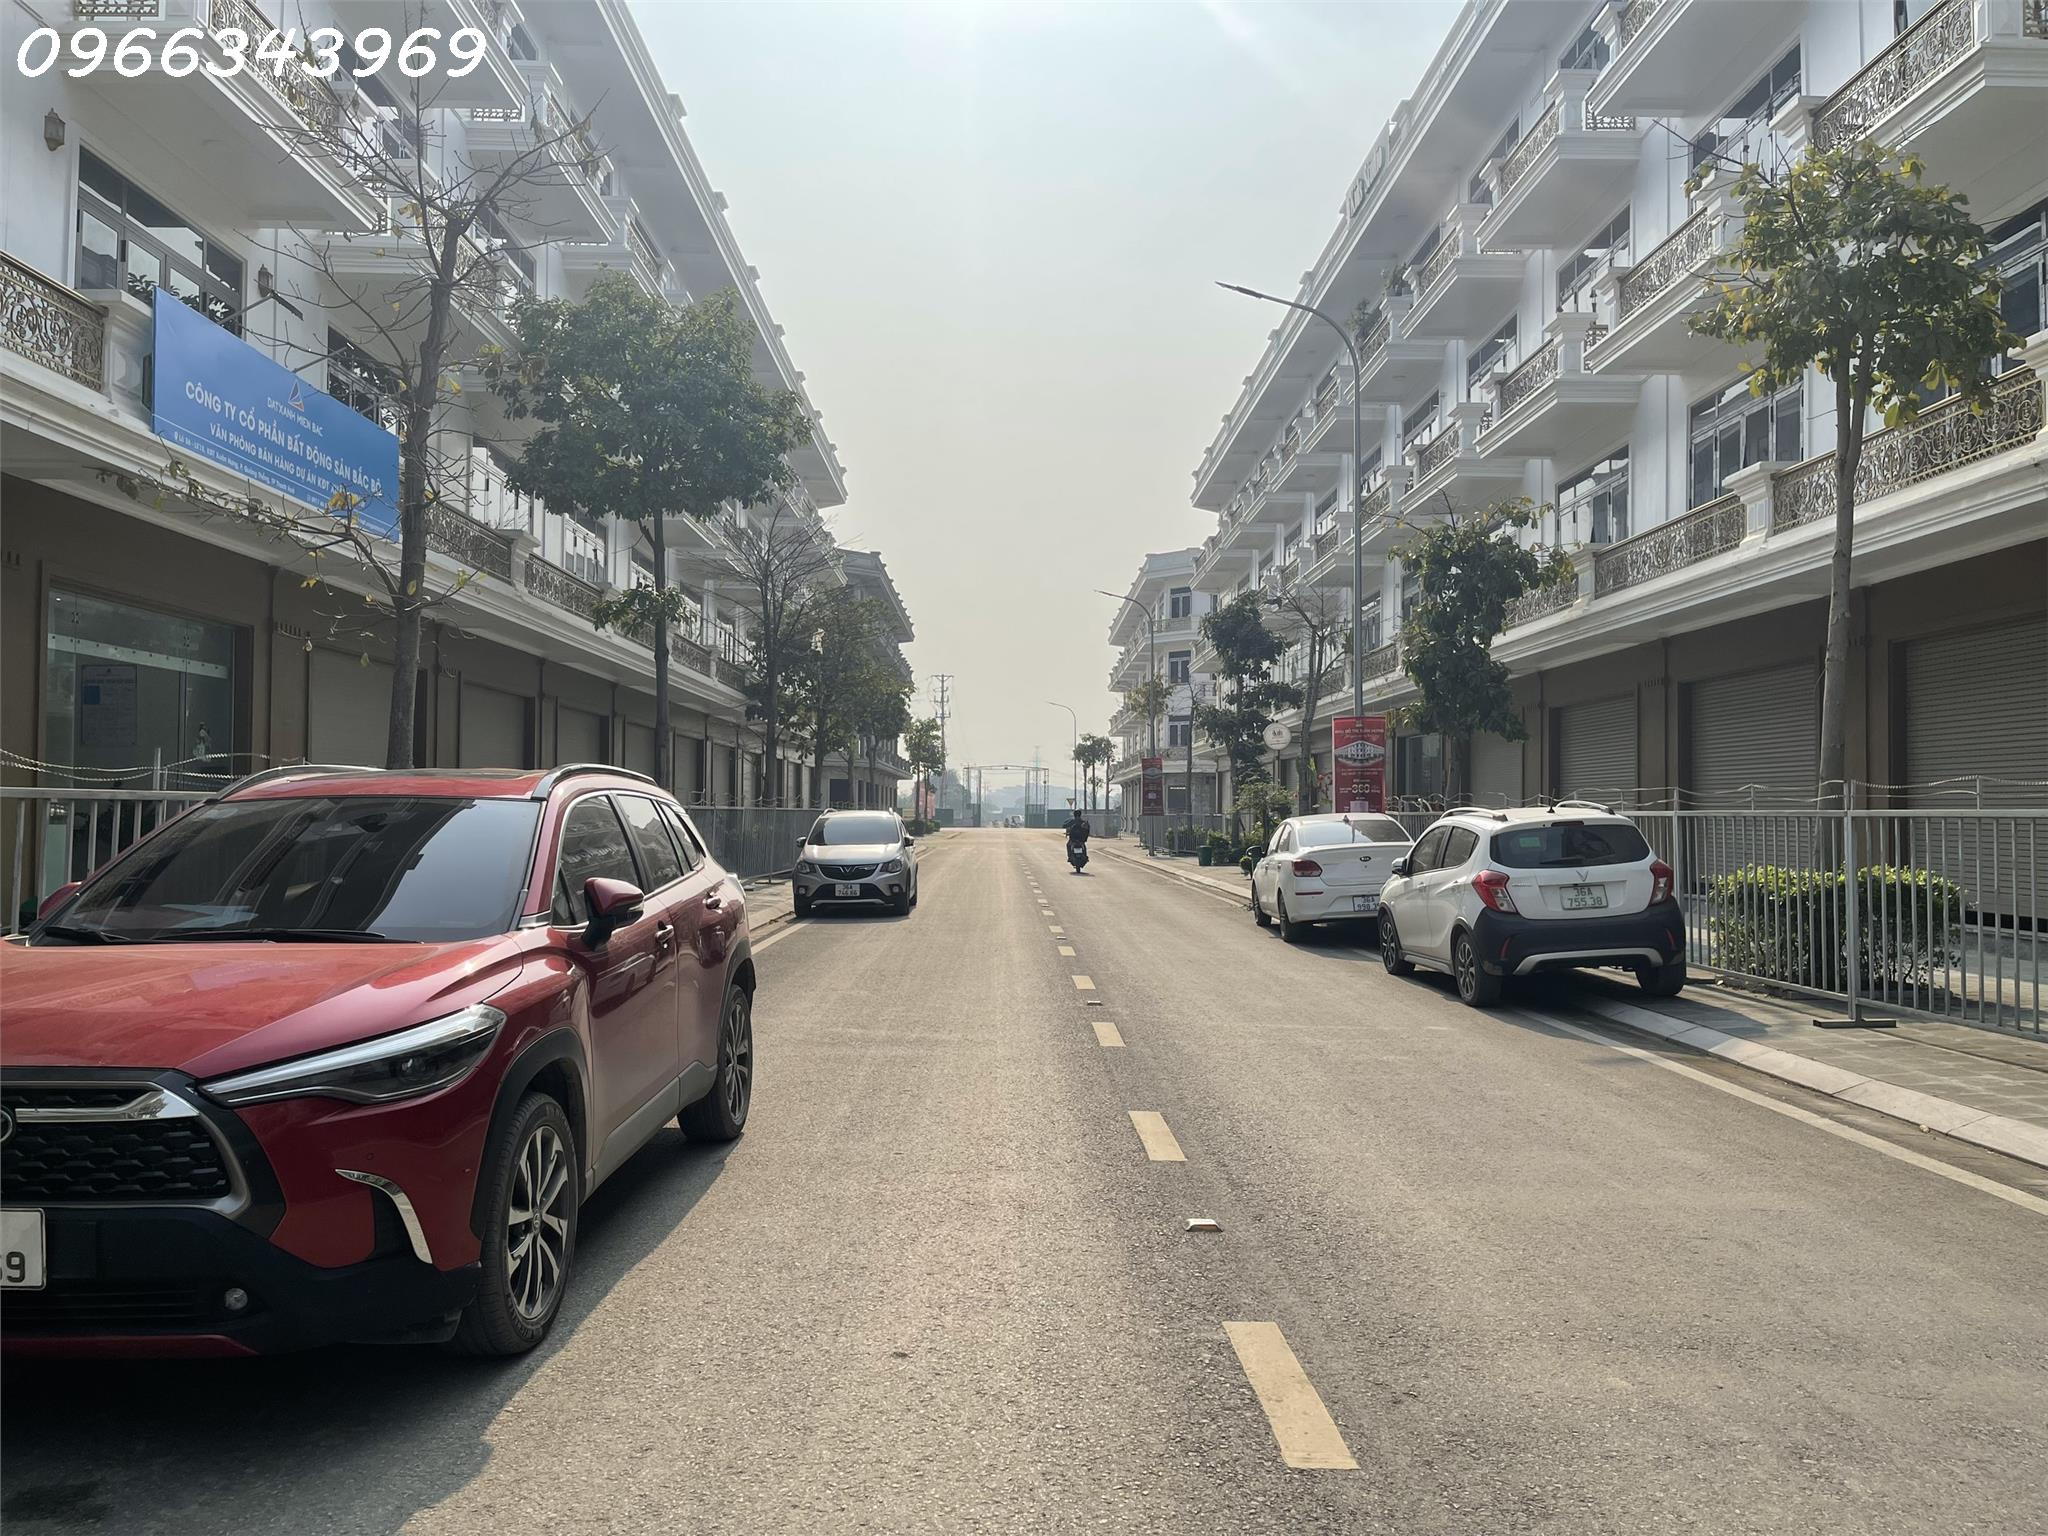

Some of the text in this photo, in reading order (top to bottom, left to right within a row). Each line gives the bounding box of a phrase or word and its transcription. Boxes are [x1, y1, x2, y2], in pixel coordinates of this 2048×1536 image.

[185, 381, 221, 413] CÔNG
[224, 401, 237, 421] TY
[239, 406, 256, 431] CỔ
[258, 419, 285, 447] PHẦN
[287, 433, 304, 456] BẤT
[306, 445, 333, 471] ĐỘNG
[334, 457, 350, 481] SẢN
[352, 466, 369, 489] BẮC
[210, 422, 227, 442] VĂN
[229, 431, 257, 456] PHÒNG
[296, 466, 306, 481] DỰ
[1568, 896, 1603, 908] 755.38
[1573, 887, 1593, 897] 36A
[0, 1251, 26, 1284] 9
